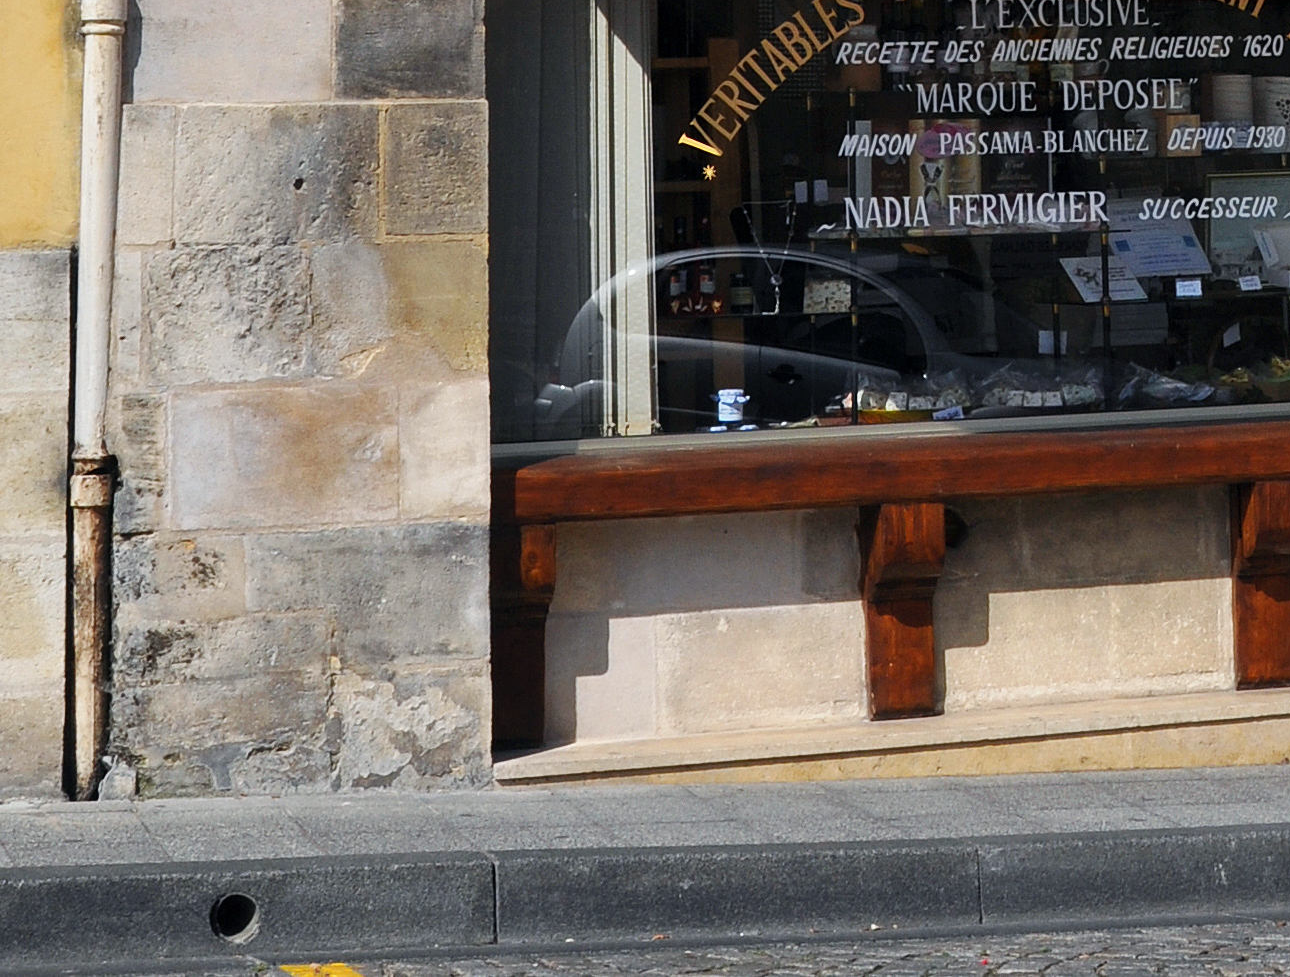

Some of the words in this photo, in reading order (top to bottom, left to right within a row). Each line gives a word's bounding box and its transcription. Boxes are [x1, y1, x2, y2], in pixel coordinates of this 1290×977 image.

[835, 40, 936, 65] RECETTE
[944, 40, 984, 64] DES
[992, 36, 1102, 63] ANCIENNES
[1109, 34, 1234, 61] RELIGIEUSES
[838, 132, 917, 158] MAISON
[938, 128, 1149, 156] PASSAMA-BLANCHEZ
[1166, 127, 1236, 151] DEPUIS
[1244, 125, 1286, 150] 1930
[843, 195, 930, 231] NADIA
[947, 189, 1110, 227] FERMIGIER
[1138, 195, 1278, 221] SUCCESSEUR
